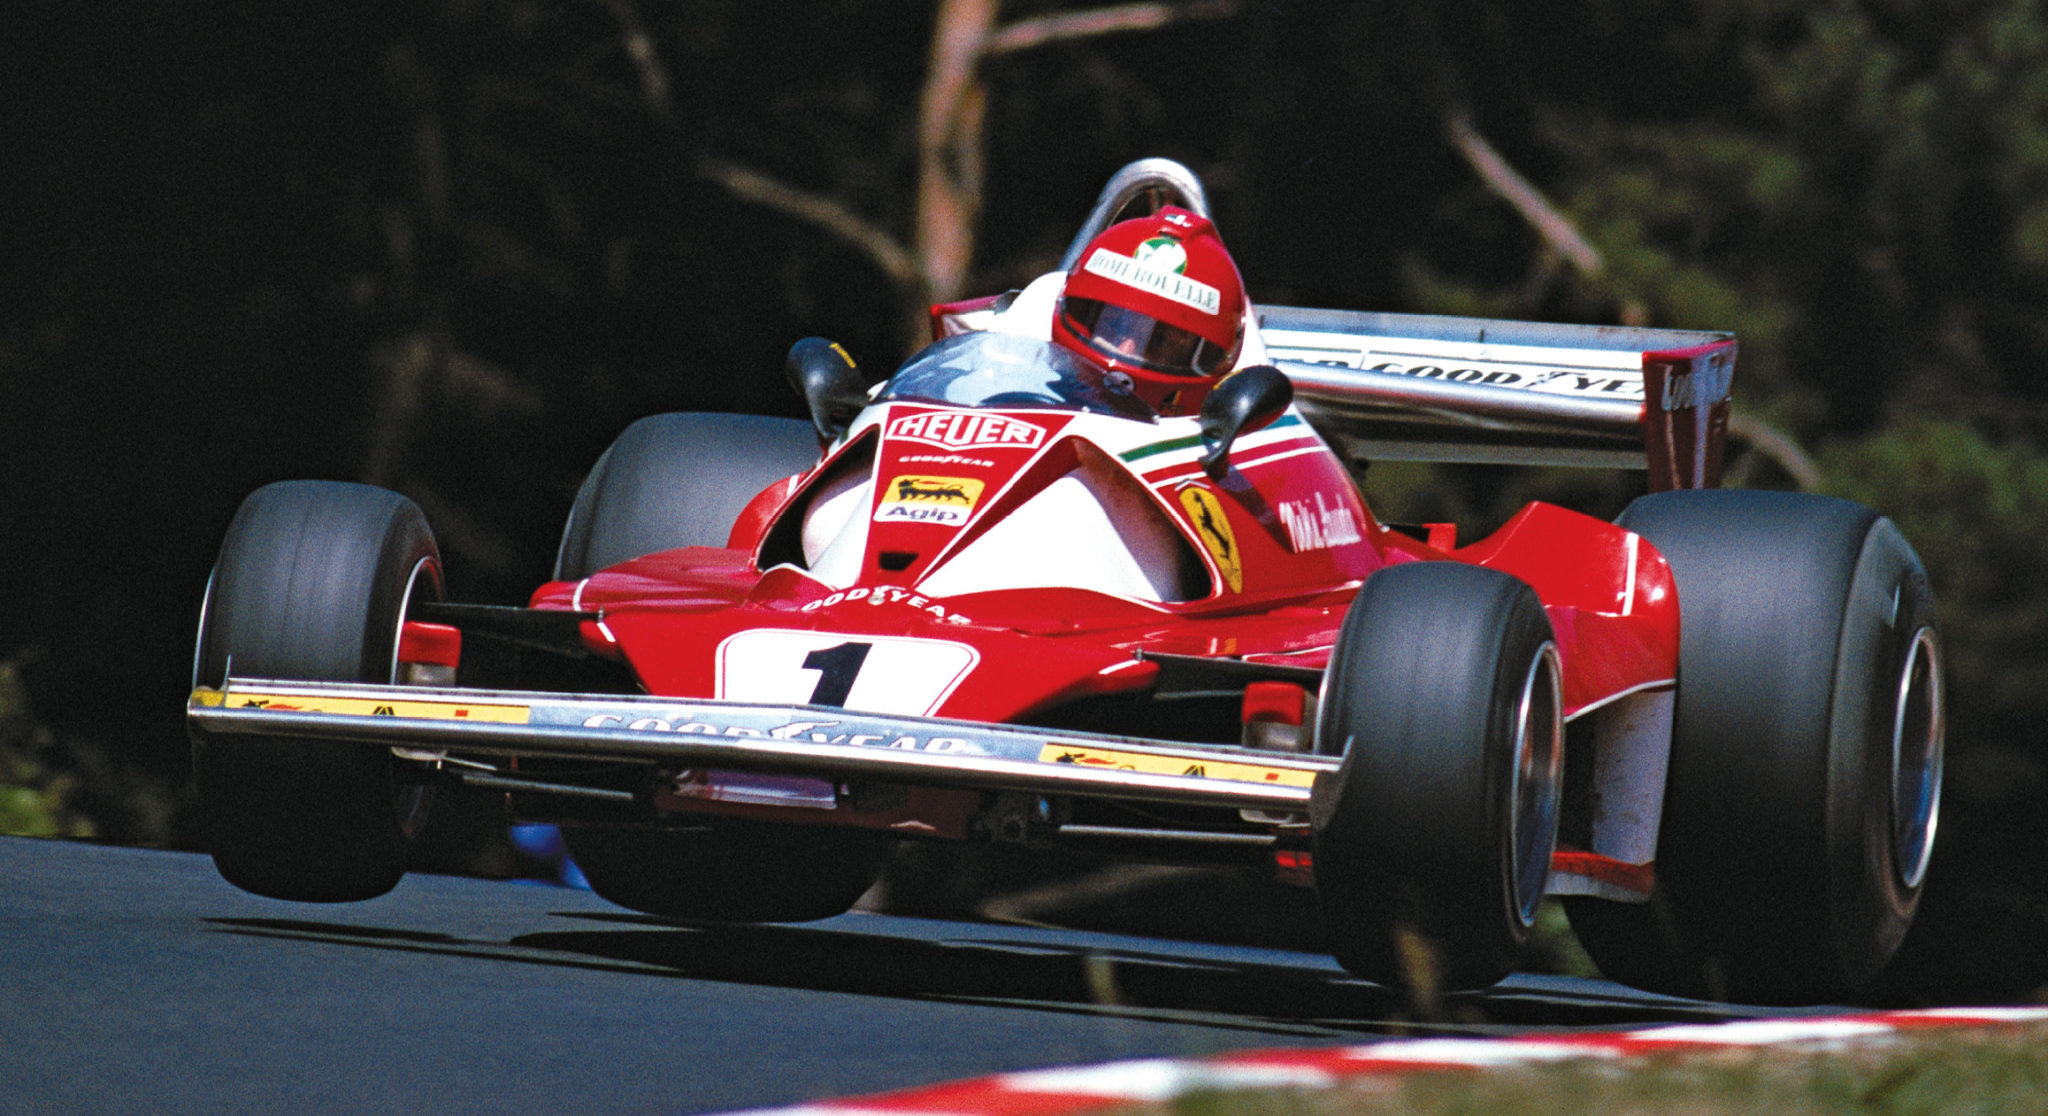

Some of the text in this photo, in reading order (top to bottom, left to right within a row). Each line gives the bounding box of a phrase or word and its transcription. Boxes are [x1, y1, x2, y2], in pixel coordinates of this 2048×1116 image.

[1371, 363, 1643, 394] GOODYE
[899, 414, 1030, 446] HEUER
[899, 455, 995, 467] GOODYEAR
[885, 506, 959, 522] Agip
[801, 585, 973, 625] OODYEAR
[801, 641, 874, 709] 1
[582, 714, 968, 754] GOOYAR
